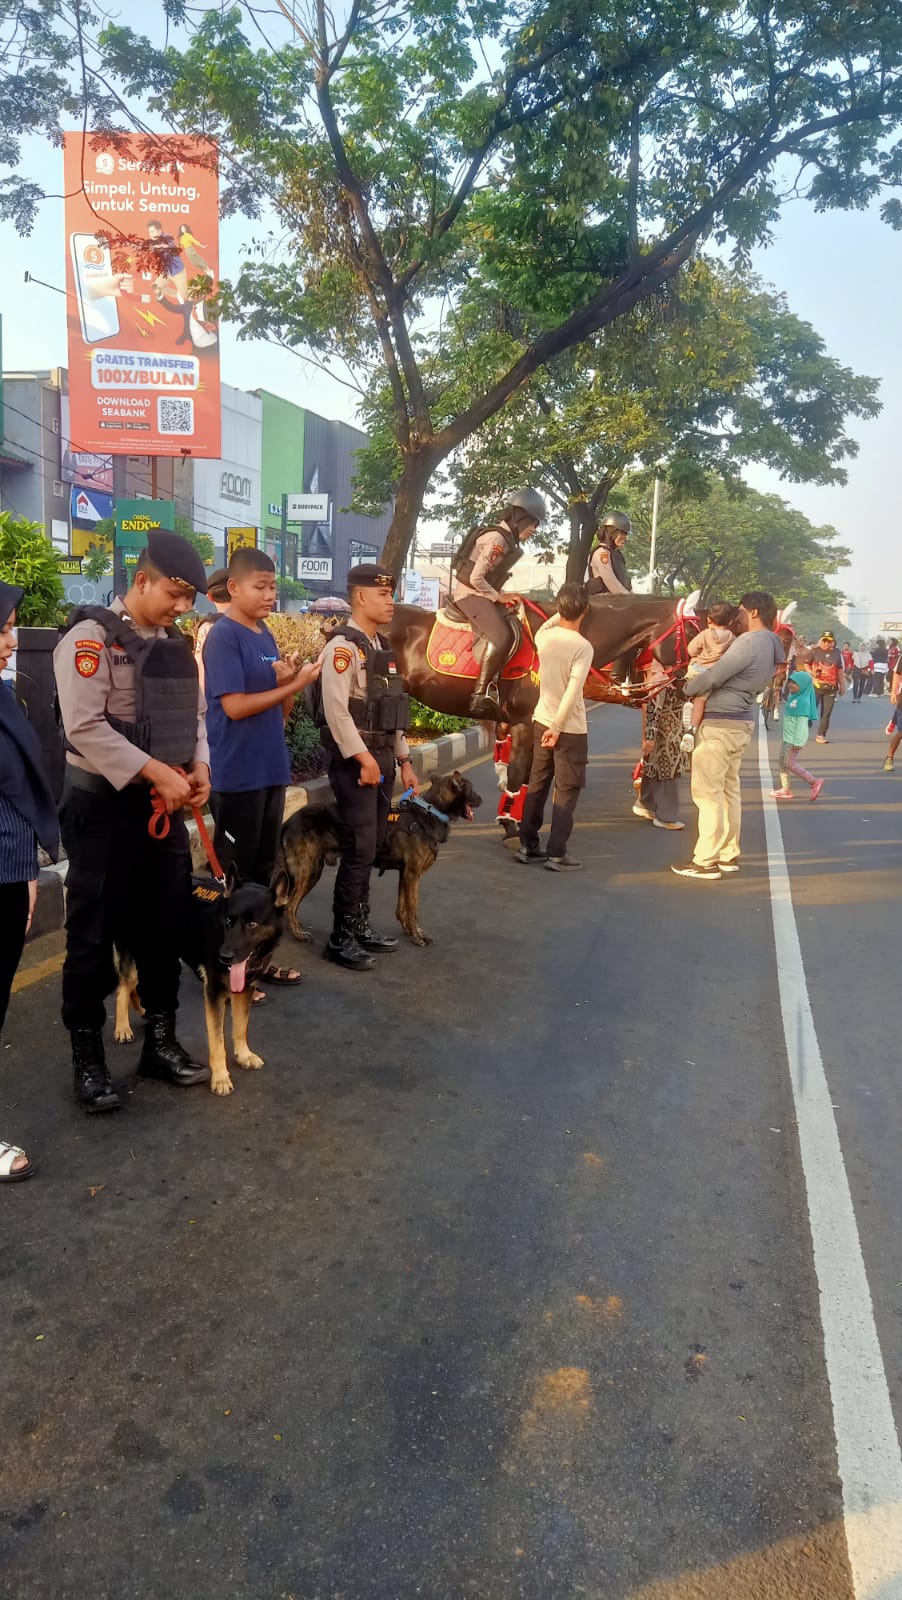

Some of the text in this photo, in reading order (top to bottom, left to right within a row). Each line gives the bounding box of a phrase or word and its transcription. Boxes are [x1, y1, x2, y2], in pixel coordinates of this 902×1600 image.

[83, 180, 200, 201] Simpel, Untung,
[91, 198, 190, 214] untuk Semua
[96, 354, 195, 370] GRATIS TRANSFER
[97, 369, 195, 386] 100X/BULAN
[97, 396, 151, 407] DOWNLOAD
[102, 407, 147, 418] SEABANK
[221, 472, 252, 499] FOOM
[301, 560, 329, 572] FOOM
